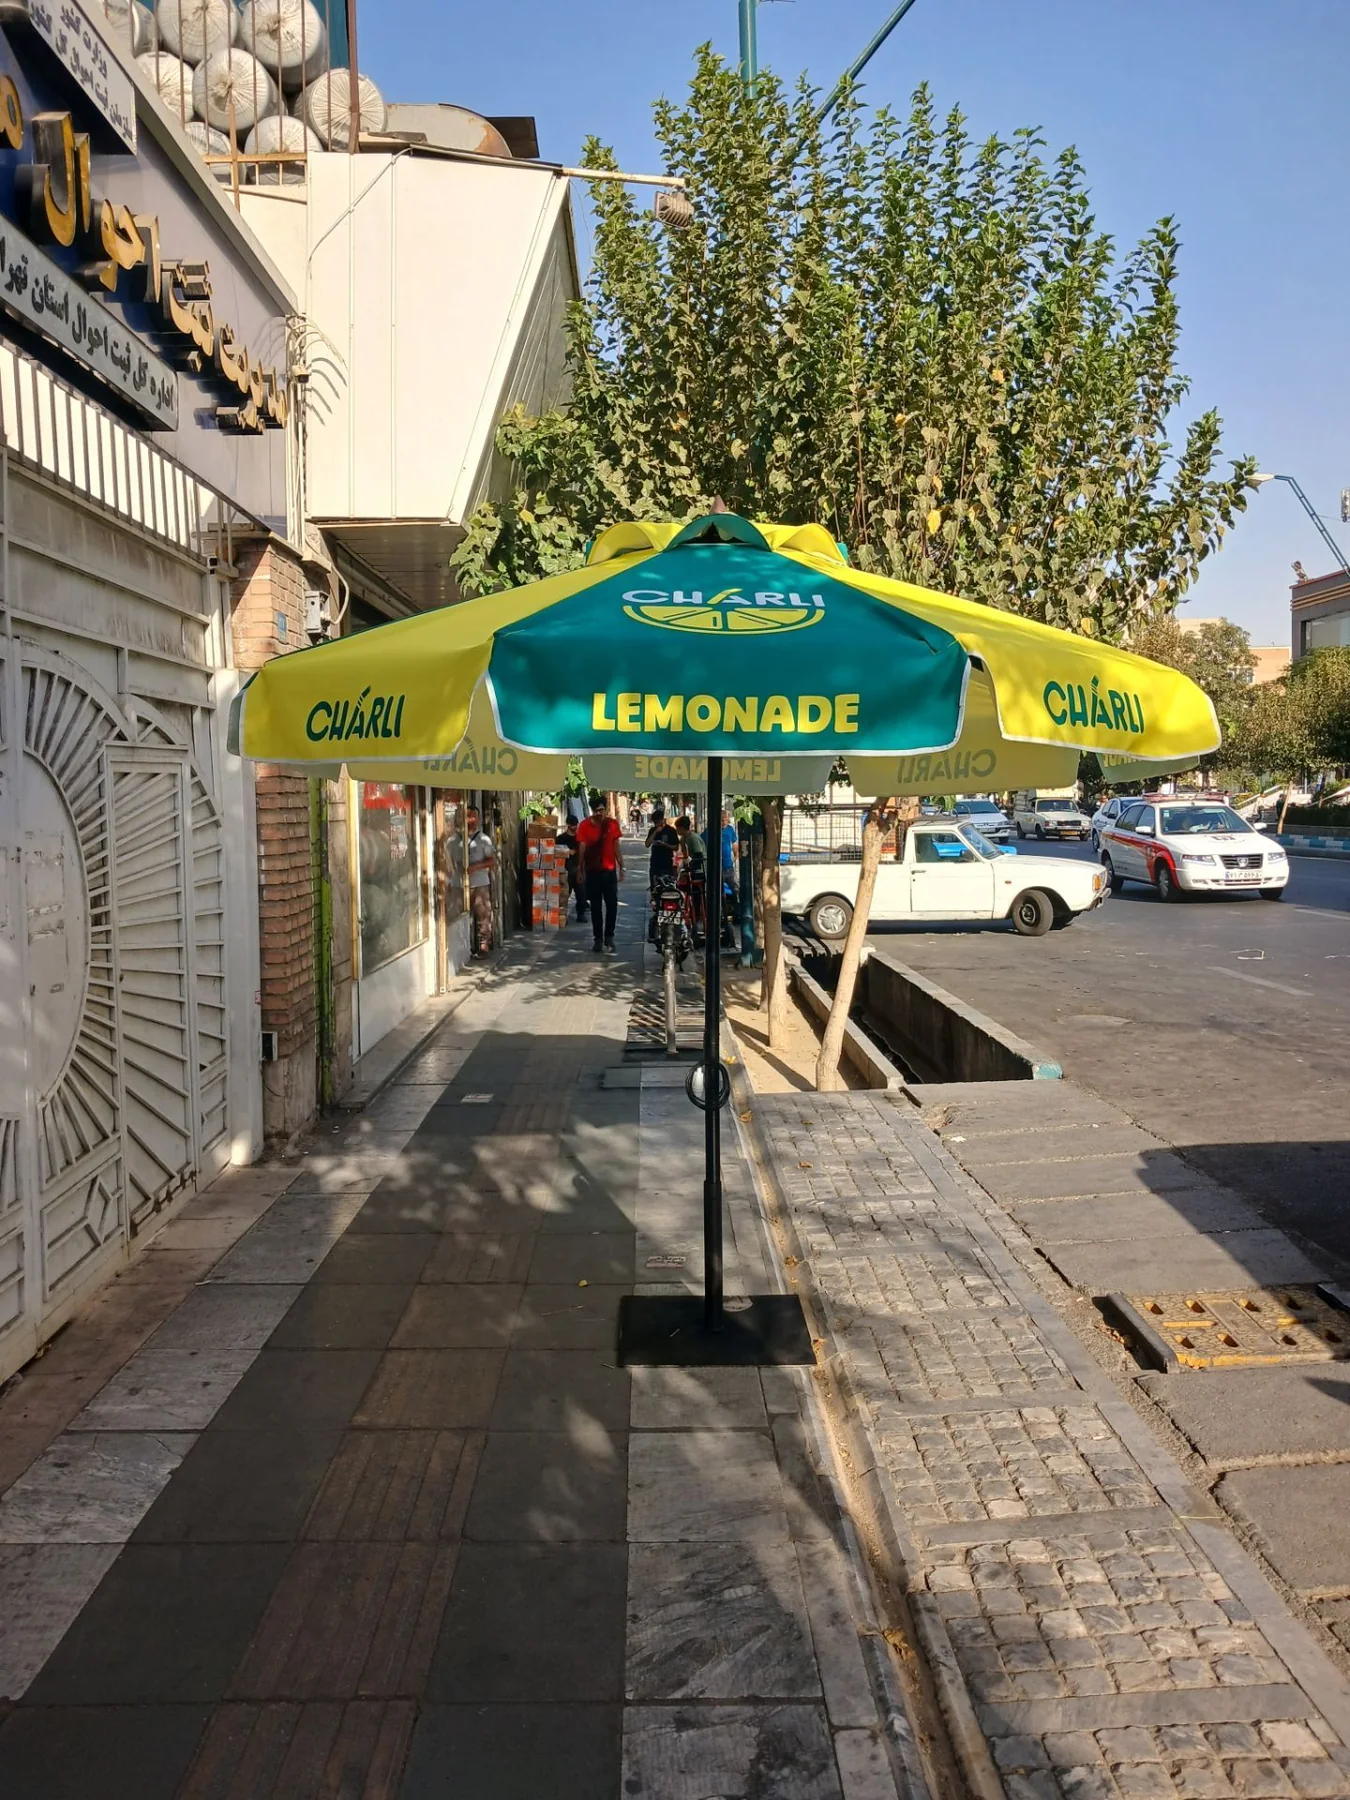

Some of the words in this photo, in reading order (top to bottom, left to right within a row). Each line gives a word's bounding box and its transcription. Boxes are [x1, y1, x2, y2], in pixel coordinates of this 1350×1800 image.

[70, 47, 93, 90] احوال
[95, 83, 108, 110] ثبت
[44, 112, 161, 303] احوال
[0, 236, 28, 295] تهرا
[31, 274, 69, 325] استان
[170, 260, 214, 372] ثبت
[72, 302, 108, 356] احوال
[110, 341, 131, 382] ثبت
[133, 356, 148, 391] کل
[150, 377, 173, 411] اداره
[621, 588, 826, 608] CHARLI
[306, 685, 405, 742] CHARLI
[592, 692, 860, 733] LEMONADE
[1043, 675, 1145, 734] CHARLI
